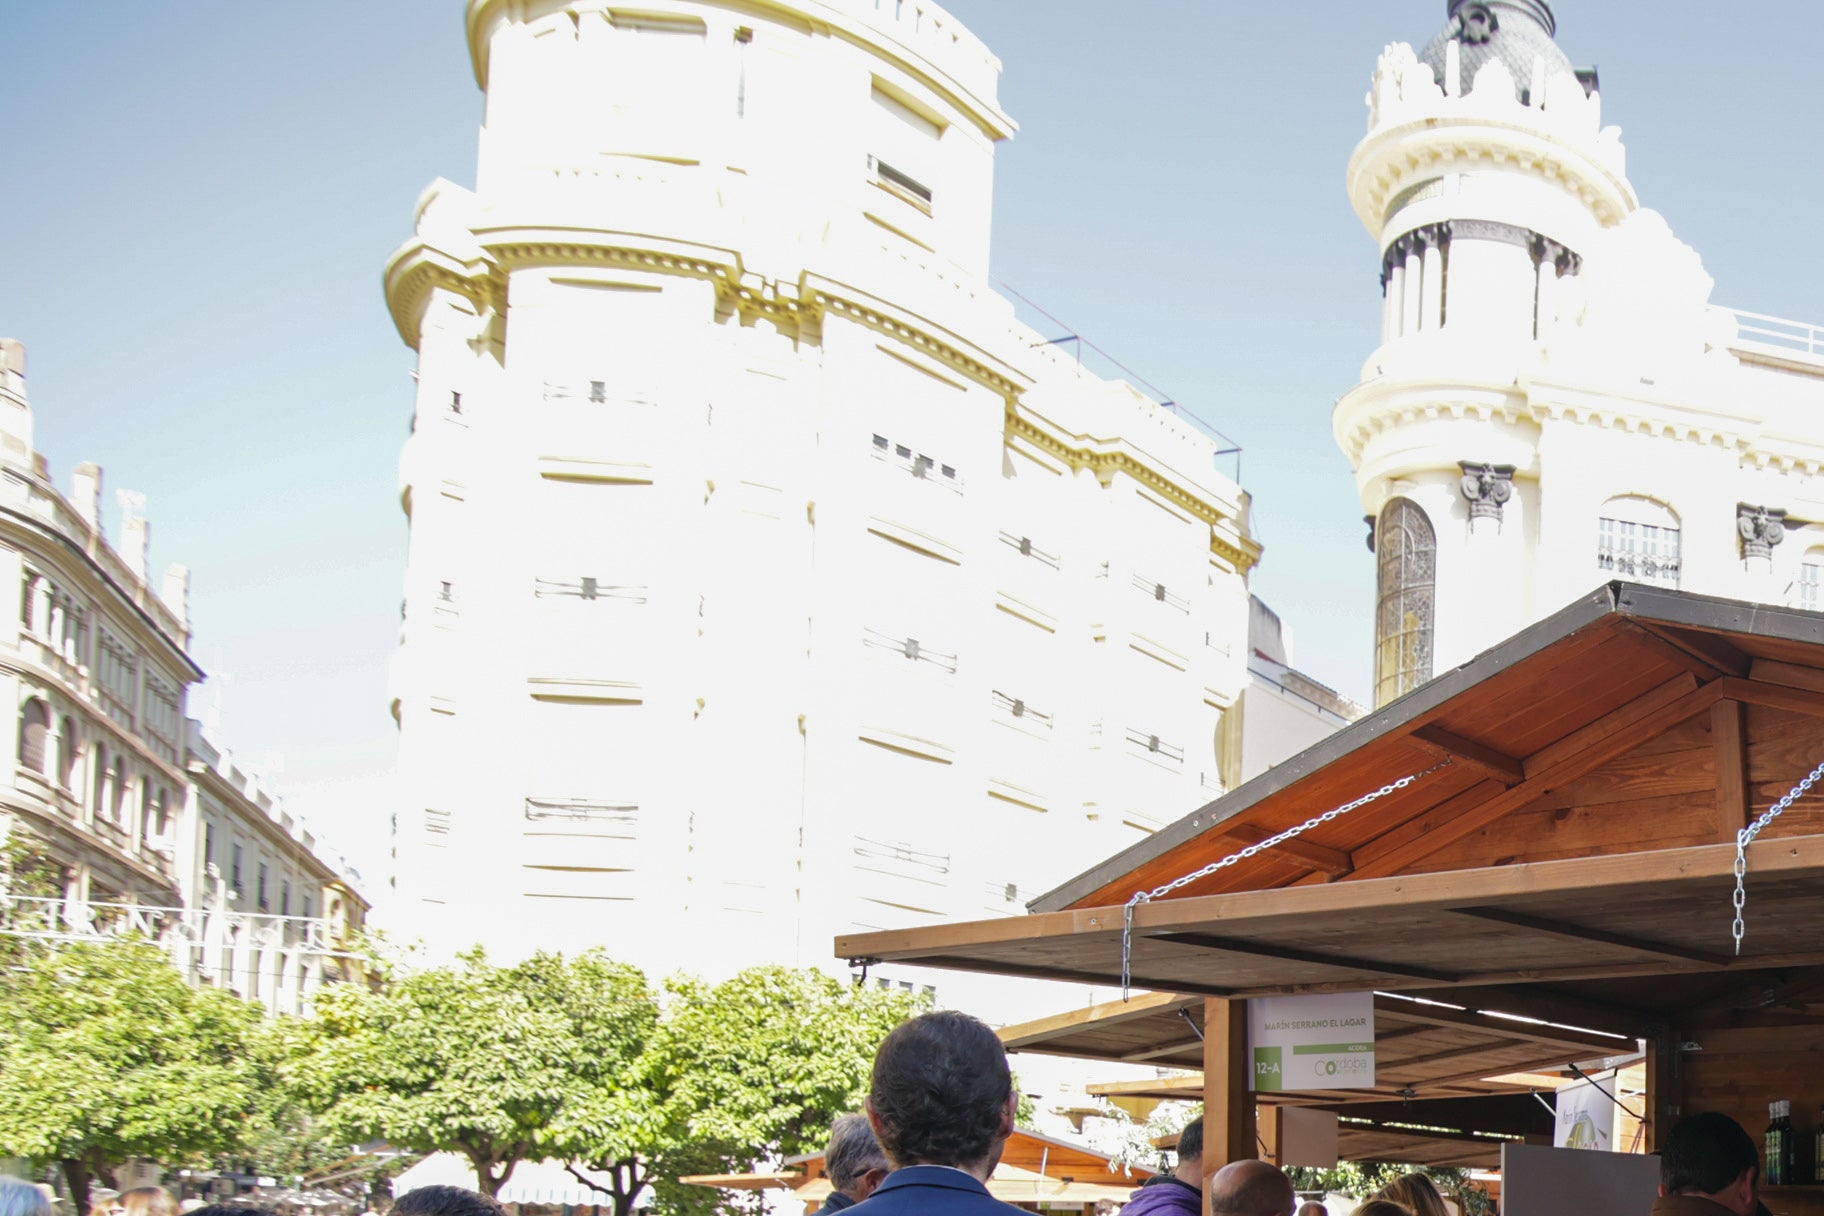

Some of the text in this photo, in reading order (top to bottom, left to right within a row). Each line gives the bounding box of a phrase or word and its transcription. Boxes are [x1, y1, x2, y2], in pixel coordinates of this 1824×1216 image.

[1264, 1018, 1367, 1031] MARÍN SERRANO EL LAGAR
[1255, 1062, 1281, 1074] 12-A
